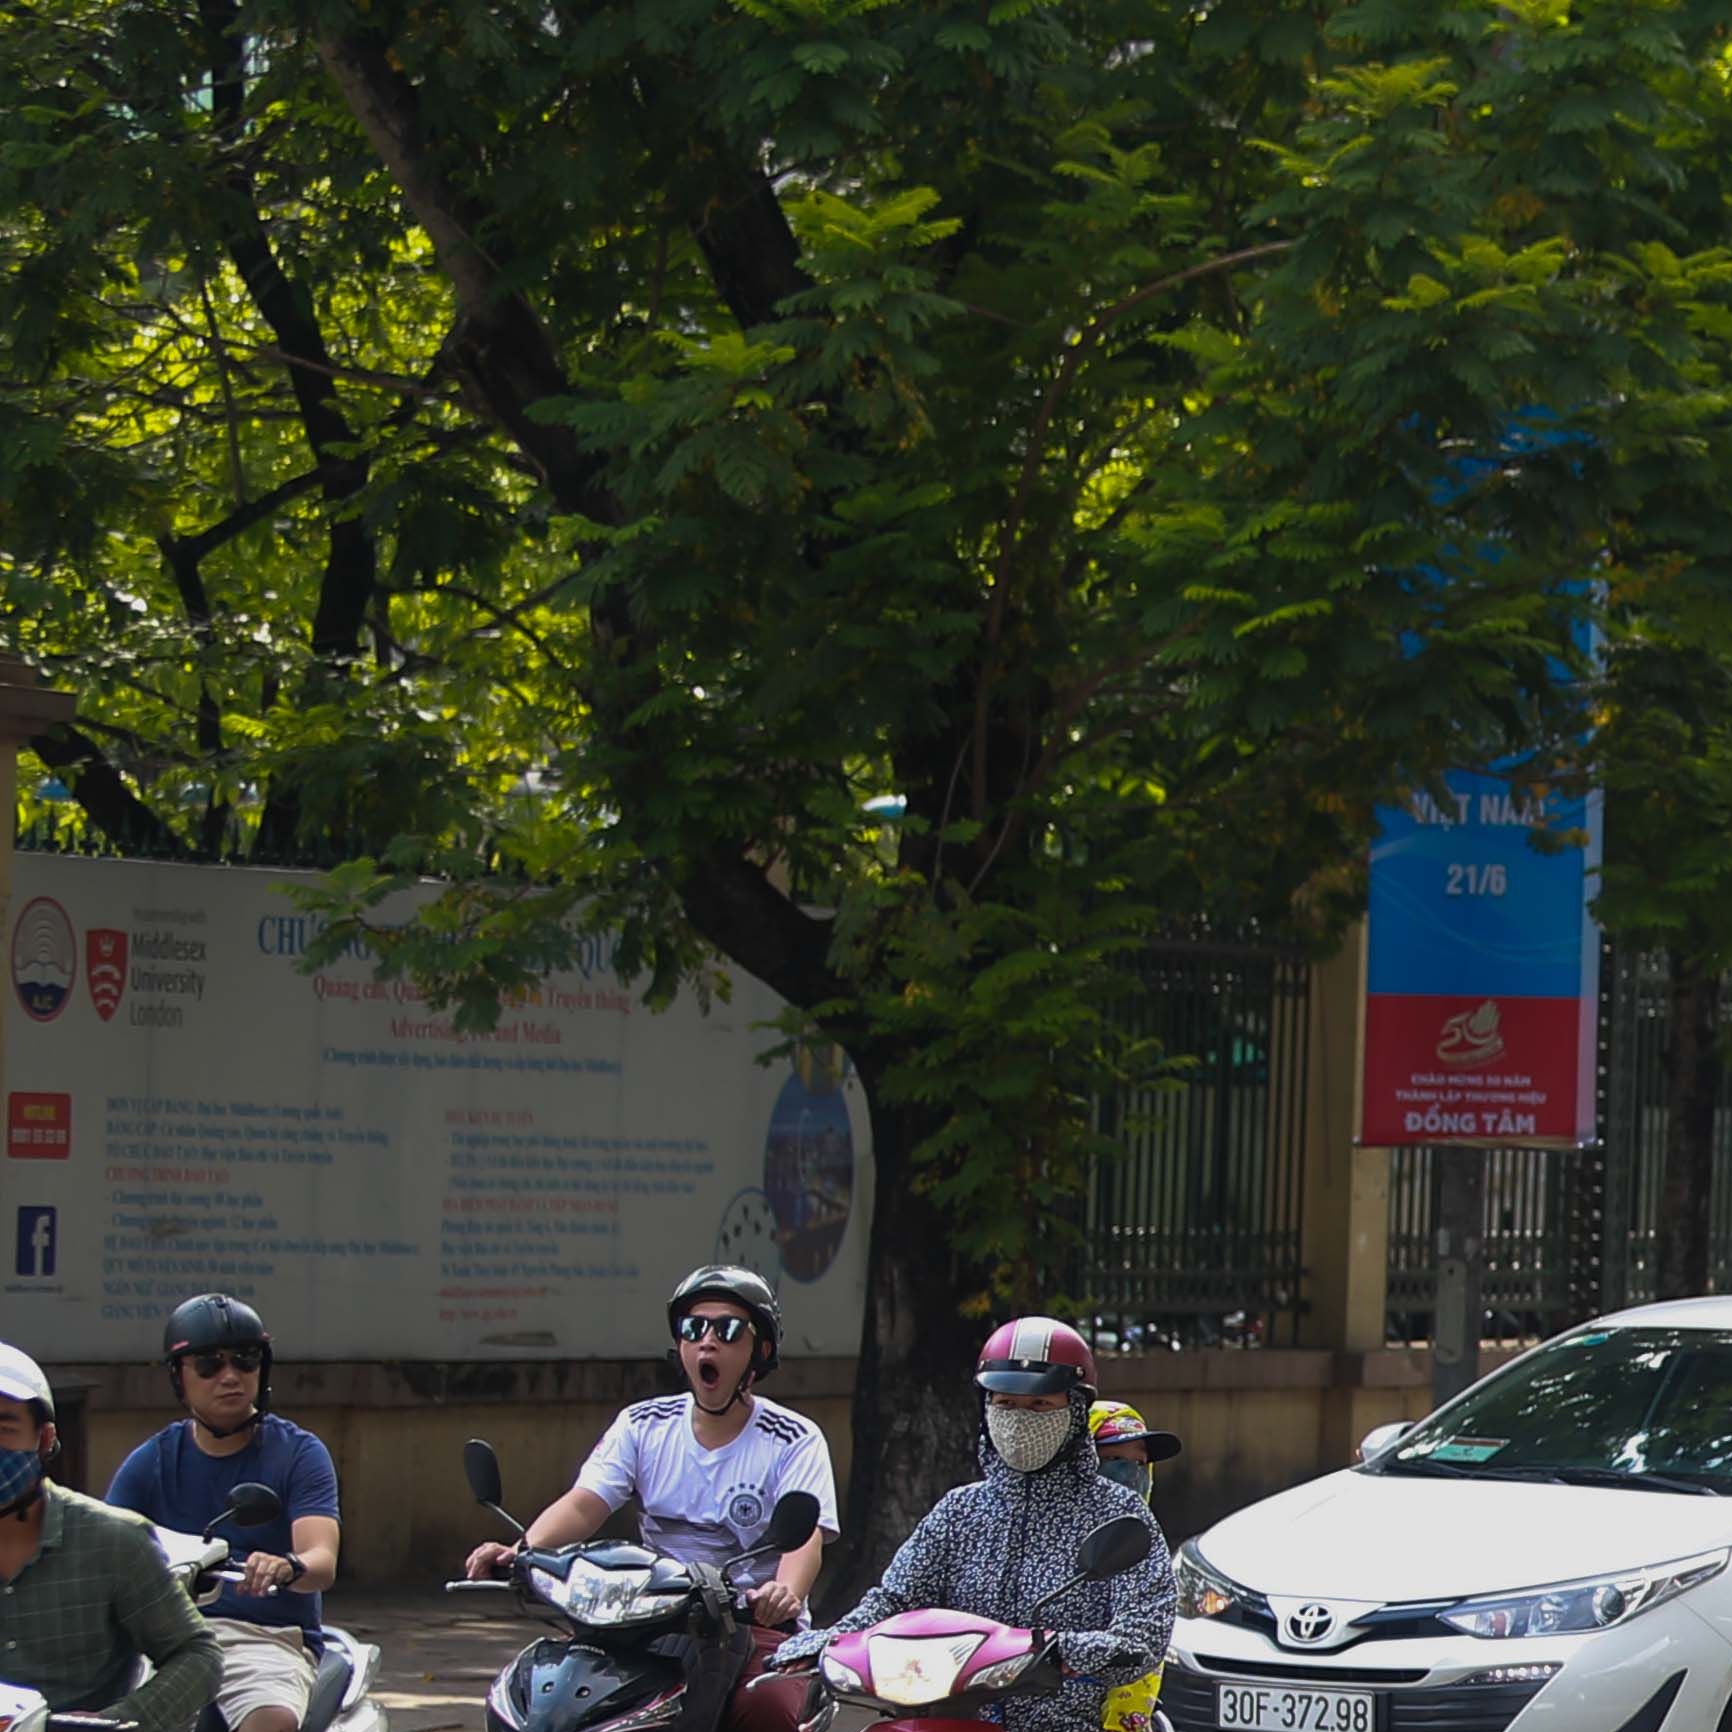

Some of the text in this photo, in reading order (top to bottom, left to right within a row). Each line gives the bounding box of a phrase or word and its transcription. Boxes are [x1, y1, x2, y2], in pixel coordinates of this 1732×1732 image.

[1445, 863, 1508, 896] 21/6
[131, 930, 207, 962] Middlesex
[131, 964, 206, 1001] University
[130, 1000, 184, 1028] London
[1481, 1107, 1537, 1135] TÂM
